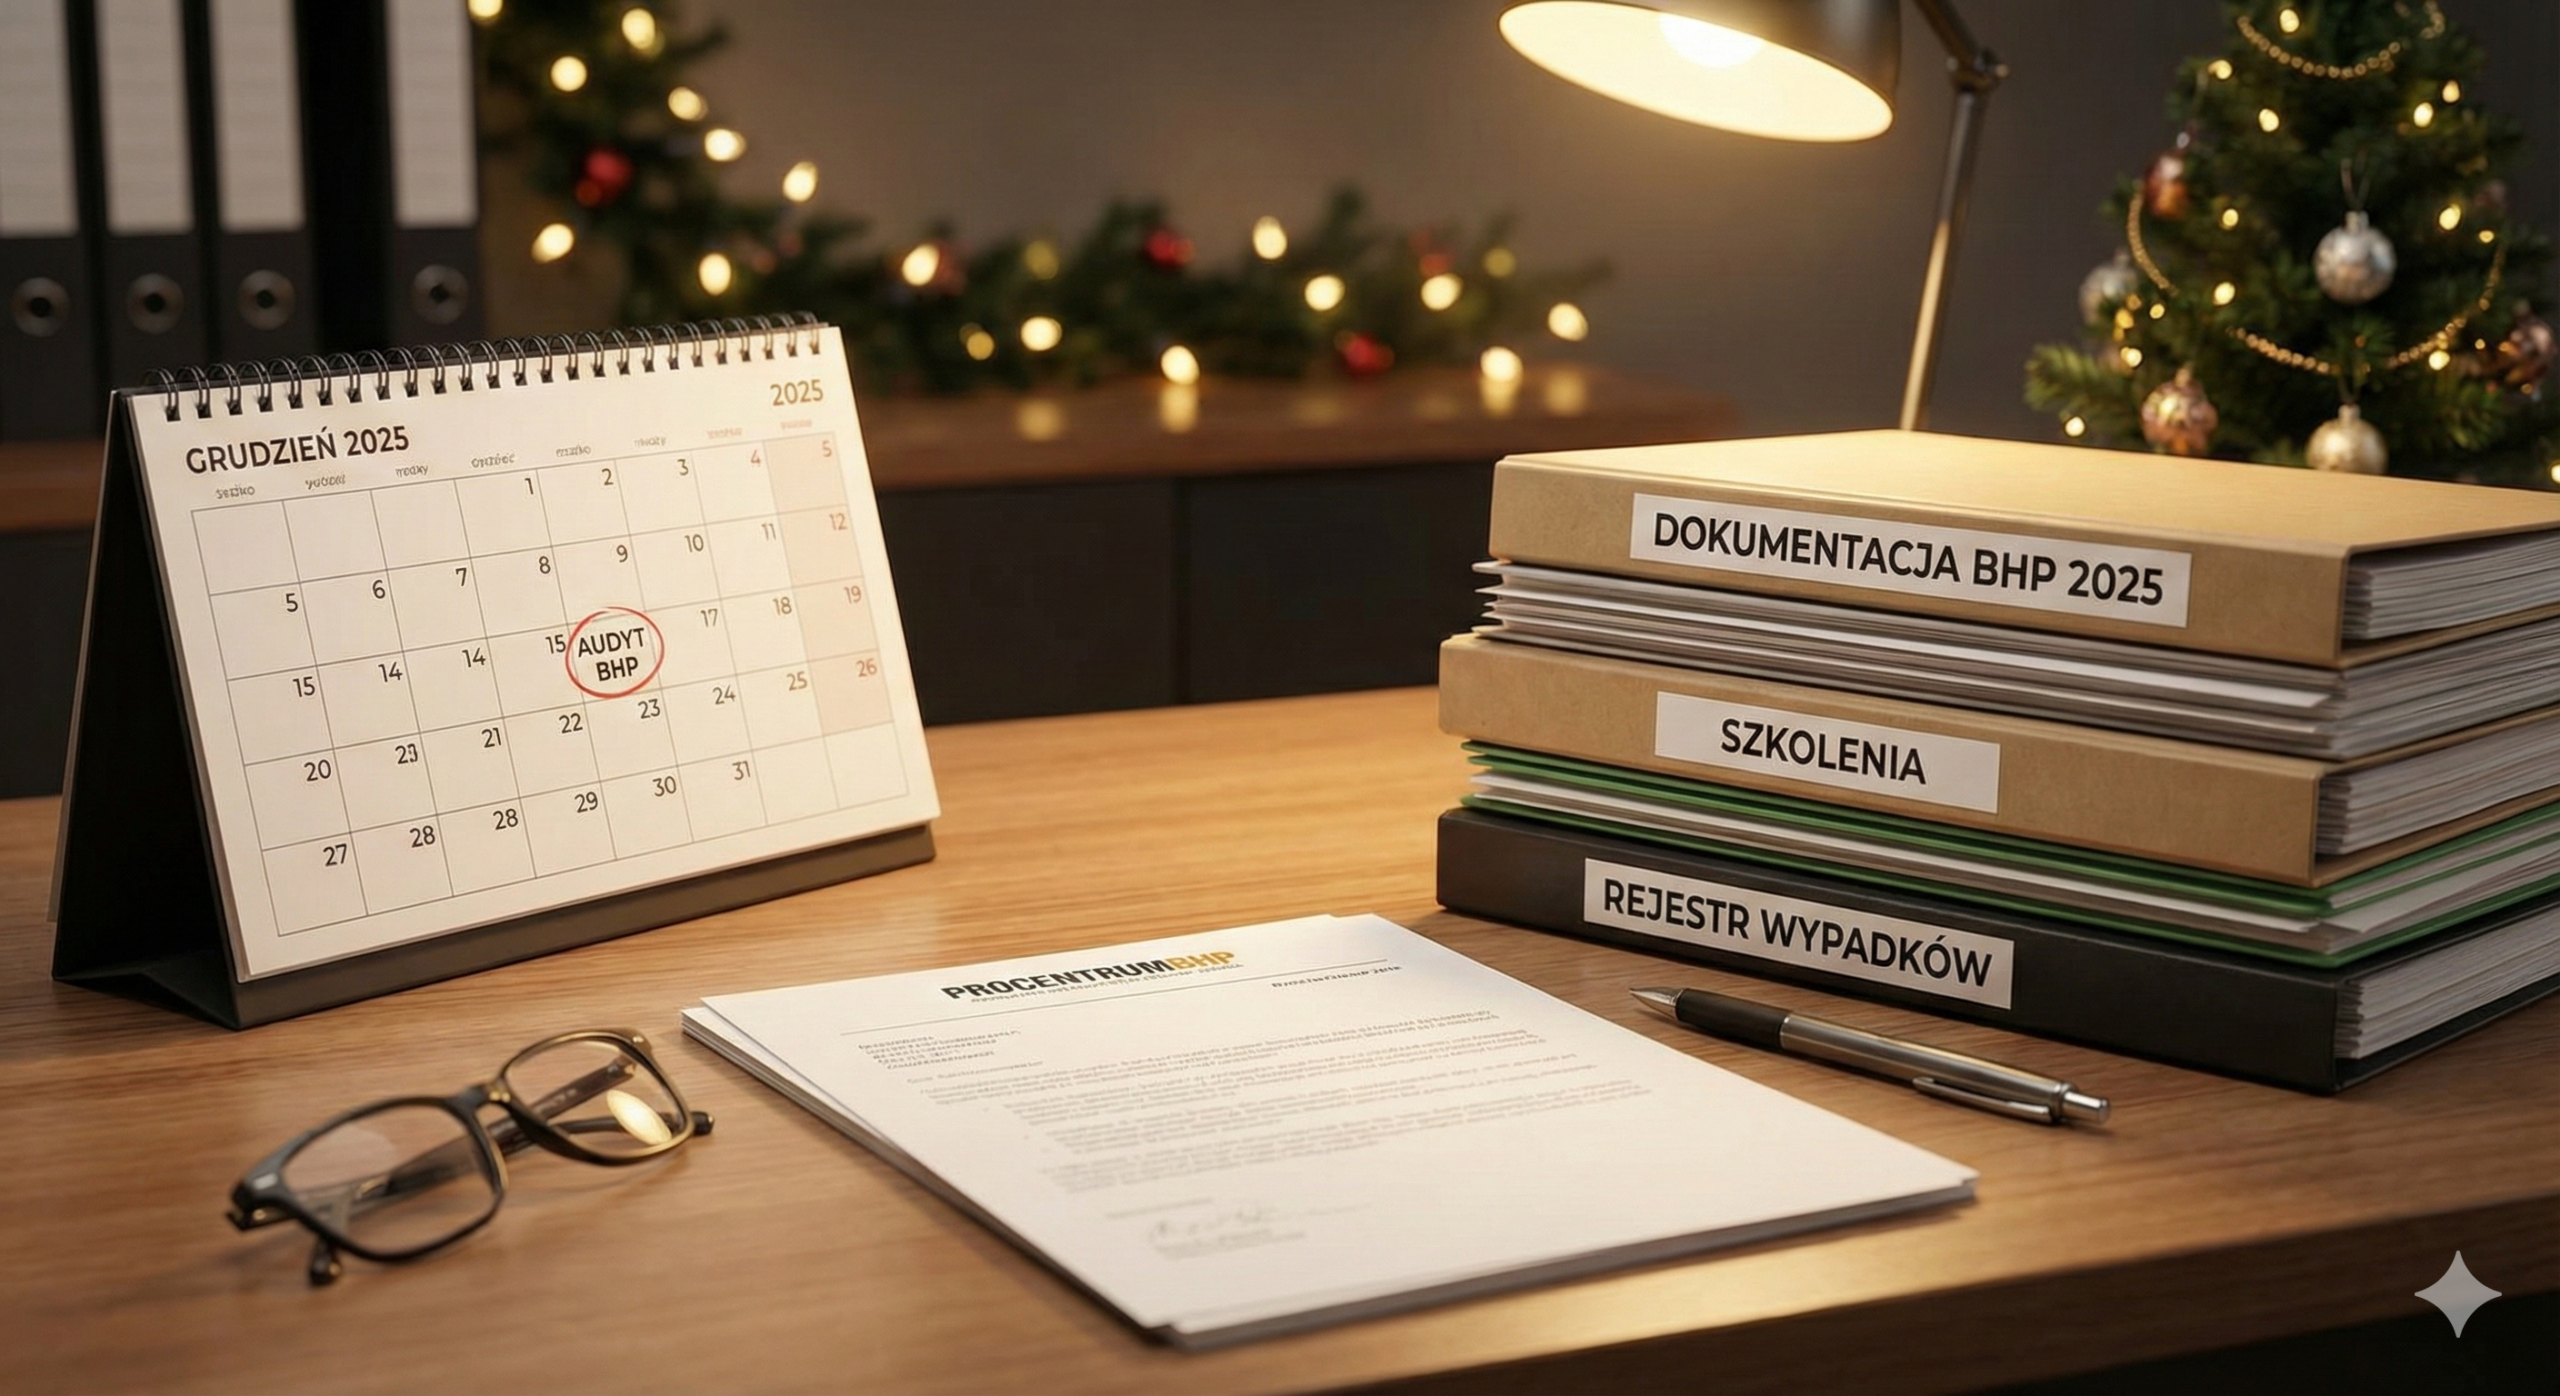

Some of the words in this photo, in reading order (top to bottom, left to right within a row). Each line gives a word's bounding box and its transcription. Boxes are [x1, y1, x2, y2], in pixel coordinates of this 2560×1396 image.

[769, 378, 824, 407] 2025
[185, 425, 337, 474] GRUDZIEŃ
[343, 425, 409, 457] 2025
[524, 477, 534, 495] 1
[601, 467, 614, 486] 2
[677, 458, 689, 477] 3
[750, 449, 762, 465] 4
[822, 440, 833, 458] 5
[285, 592, 299, 613] 5
[372, 579, 386, 600] 6
[455, 567, 467, 587] 7
[538, 555, 552, 575] 8
[616, 544, 629, 563] 9
[684, 533, 704, 553] 10
[761, 522, 777, 541] 11
[828, 512, 848, 531] 12
[1653, 512, 1961, 583] DOKUMENTACJA
[1973, 548, 2057, 592] BHP
[2067, 559, 2163, 606] 2025
[292, 676, 316, 698] 15
[378, 661, 403, 683] 14
[461, 647, 487, 668] 14
[545, 634, 567, 655] 15
[700, 608, 718, 628] 17
[772, 596, 793, 615] 18
[843, 585, 862, 604] 19
[577, 628, 645, 658] AUDYT
[596, 657, 639, 681] BHP
[303, 759, 332, 782] 20
[481, 727, 502, 749] 21
[558, 712, 584, 734] 22
[637, 698, 661, 720] 23
[712, 685, 736, 706] 24
[786, 670, 808, 692] 25
[855, 657, 878, 678] 26
[1720, 718, 1927, 785] SZKOLENIA
[322, 843, 348, 867] 27
[409, 825, 436, 848] 28
[492, 808, 519, 831] 28
[574, 791, 599, 814] 29
[652, 775, 677, 798] 30
[731, 760, 751, 781] 31
[1604, 878, 1750, 939] REJESTR
[1760, 908, 1993, 987] WYPADKÓW
